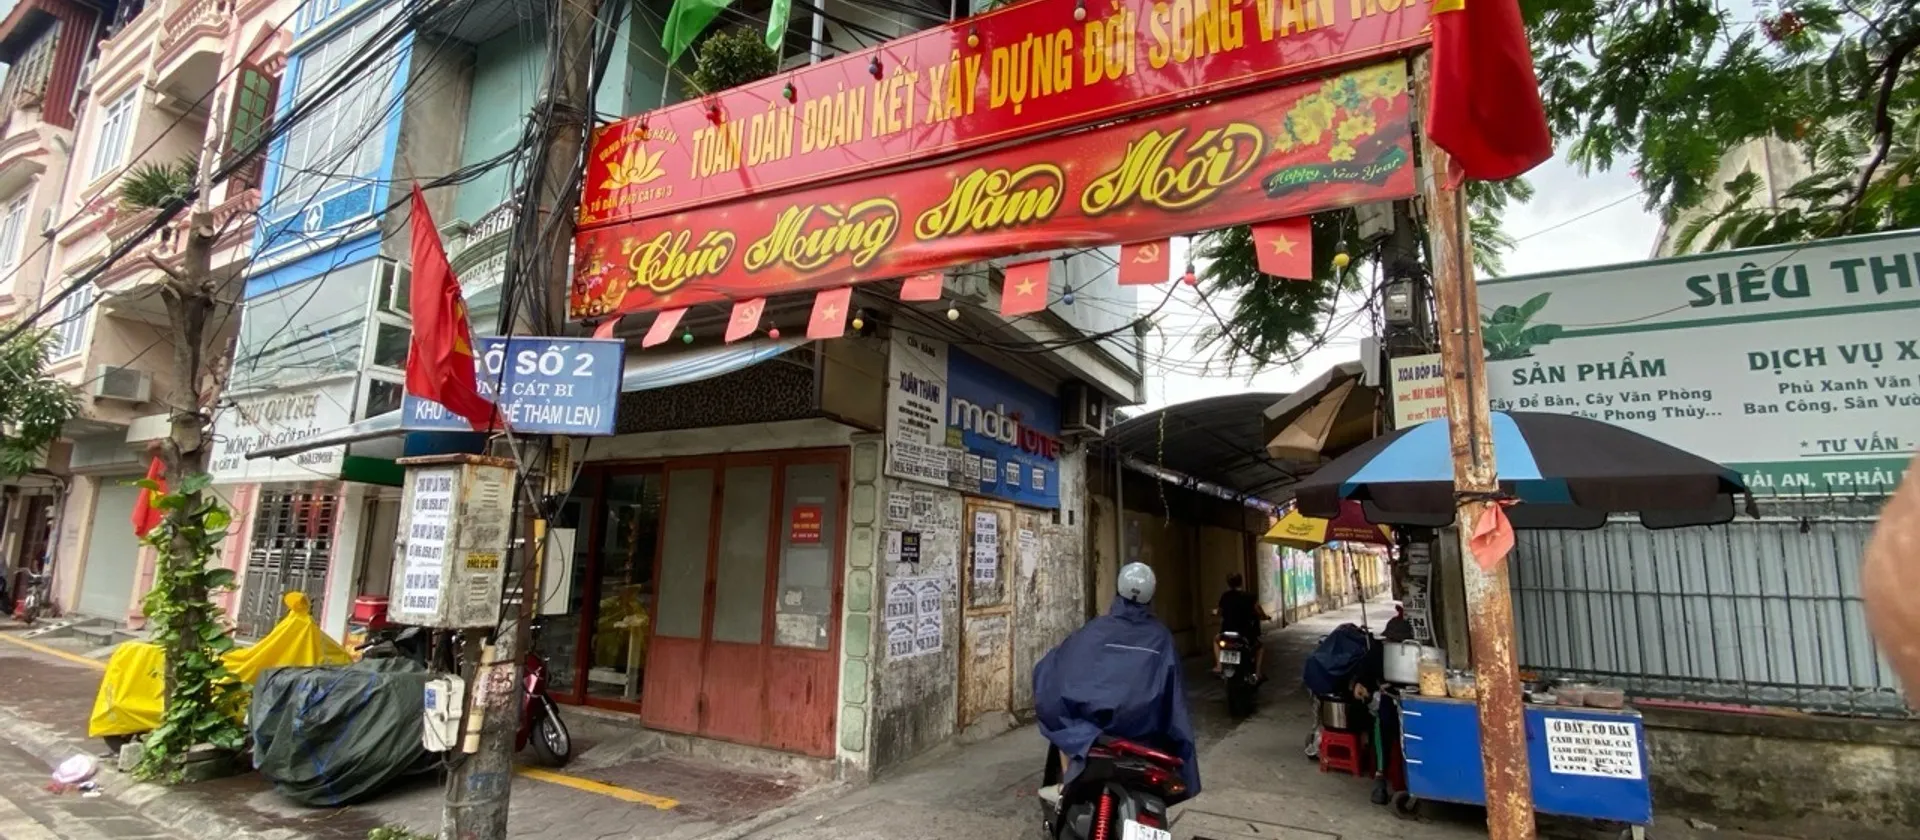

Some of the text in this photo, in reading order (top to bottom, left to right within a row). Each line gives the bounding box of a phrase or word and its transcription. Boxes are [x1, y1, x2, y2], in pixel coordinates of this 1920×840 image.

[691, 112, 745, 180] TOÀN
[748, 102, 797, 166] DÂN
[800, 87, 866, 155] ĐOÀN
[871, 57, 919, 137] KẾT
[925, 47, 981, 125] XÂY
[990, 29, 1073, 115] DỰNG
[1083, 3, 1138, 85] ĐỜI
[1268, 157, 1400, 192] Happy New Year
[627, 123, 1264, 292] Chúc Mừng Năm Mới
[1686, 262, 1811, 308] SIÊU
[515, 346, 571, 376] SỐ
[573, 353, 594, 376] 2
[1398, 366, 1414, 382] XOA
[1512, 352, 1667, 386] SẢN PHẨM
[1747, 346, 1827, 376] DỊCH
[1838, 342, 1884, 369] VỤ
[512, 380, 550, 397] CÁT
[554, 384, 574, 397] BI
[1519, 392, 1539, 409] Để
[1544, 393, 1580, 409] Bàn,
[1585, 391, 1614, 408] Cây
[1658, 388, 1712, 404] Phòng
[1778, 380, 1815, 395] Phủ
[1820, 376, 1869, 392] Xanh
[1874, 374, 1911, 389] Văn
[415, 401, 441, 420] KHU
[524, 398, 562, 424] THẢM
[566, 403, 600, 428] LEN)
[1604, 409, 1657, 424] Phong
[1744, 401, 1779, 415] Ban
[1786, 398, 1838, 416] Công,
[1844, 394, 1878, 409] Sân
[951, 396, 1062, 461] mobifone
[1817, 431, 1899, 452] TƯ VẤN
